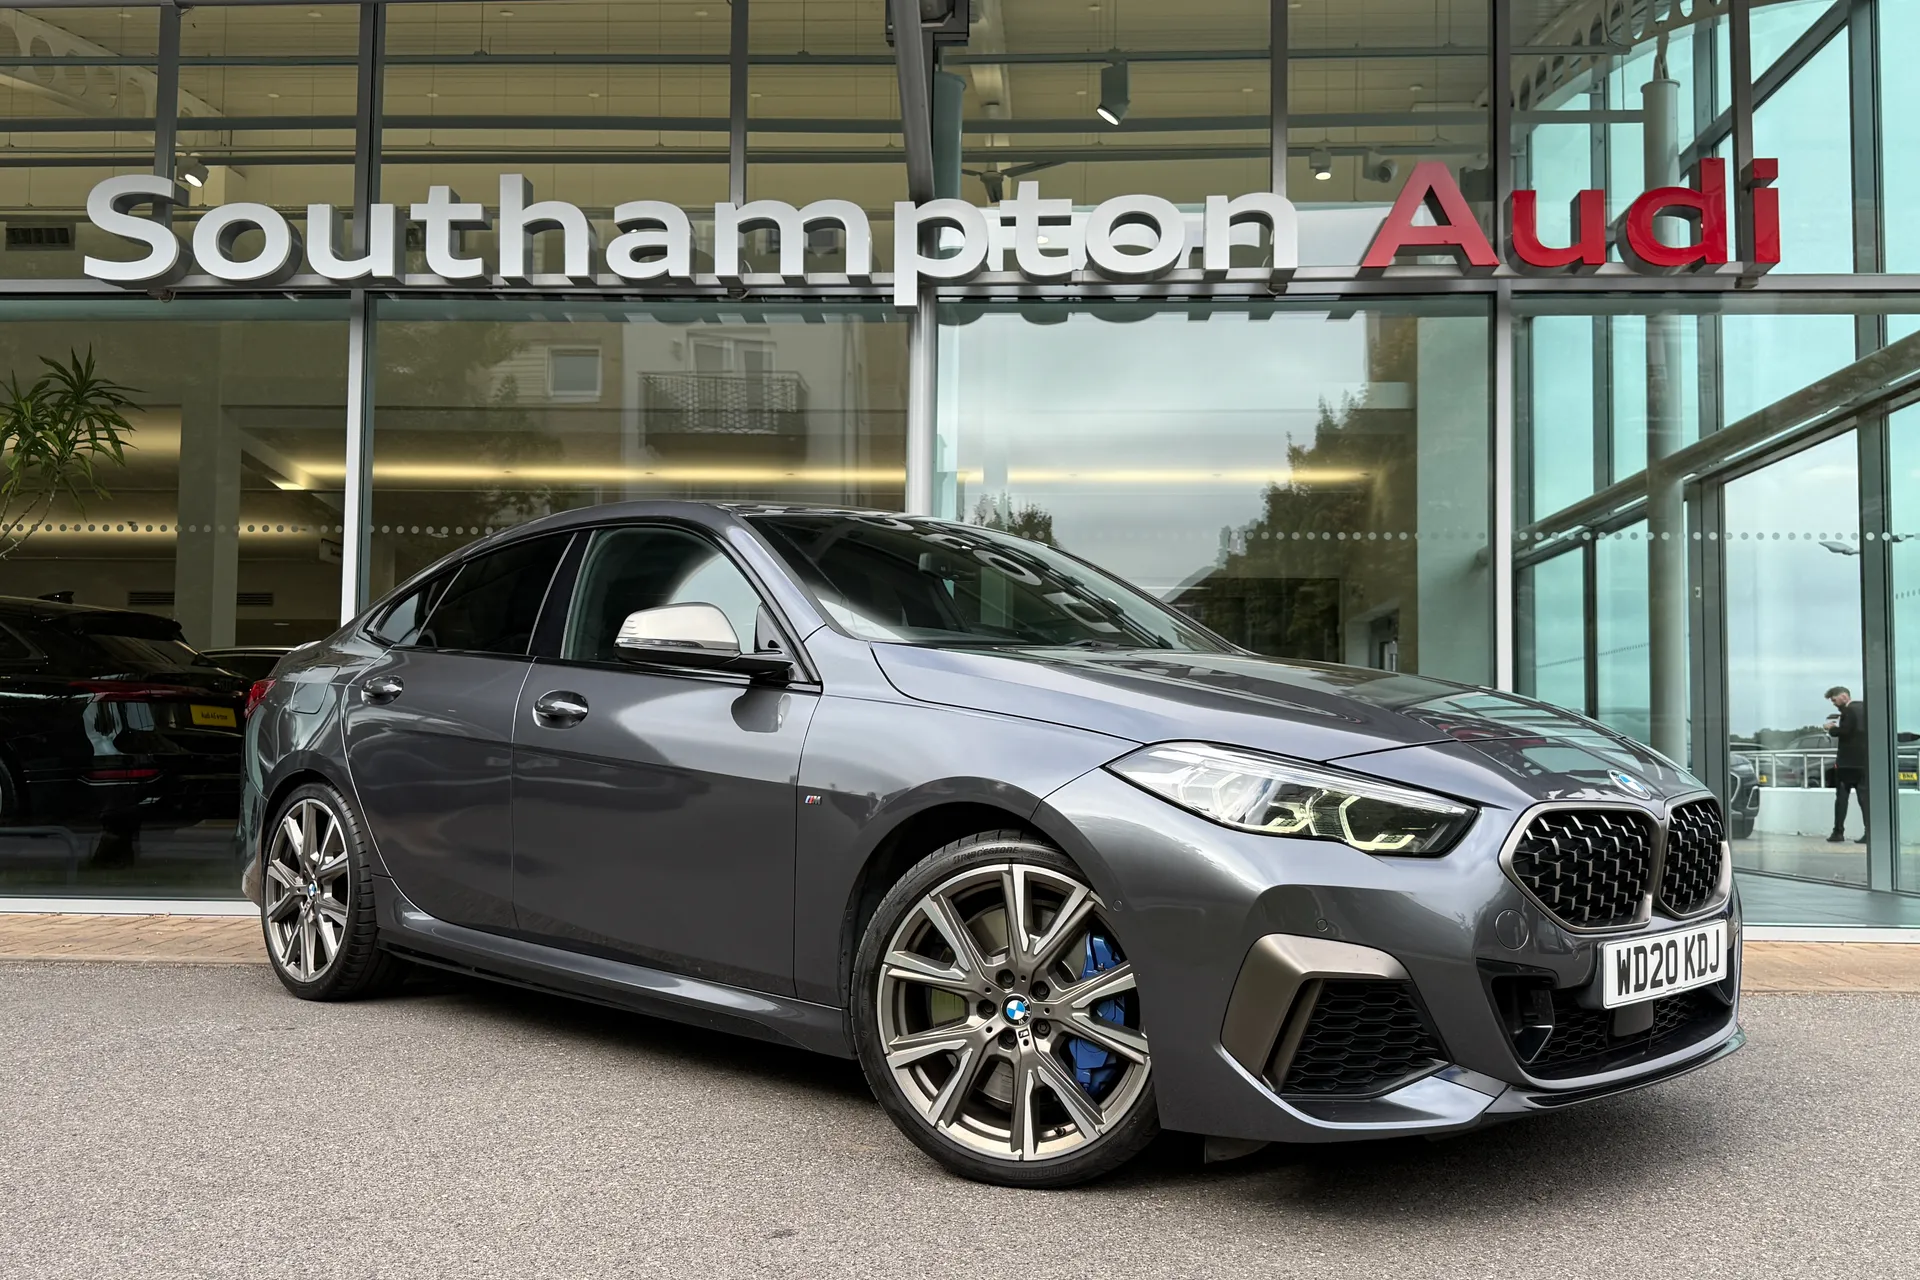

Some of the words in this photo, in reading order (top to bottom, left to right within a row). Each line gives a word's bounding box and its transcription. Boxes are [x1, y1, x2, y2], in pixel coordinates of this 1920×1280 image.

[84, 173, 1298, 313] Southampton
[1361, 157, 1781, 269] Audi
[1616, 939, 1678, 996] WD20
[1684, 929, 1720, 981] KDJ
[1018, 1000, 1031, 1025] BMW
